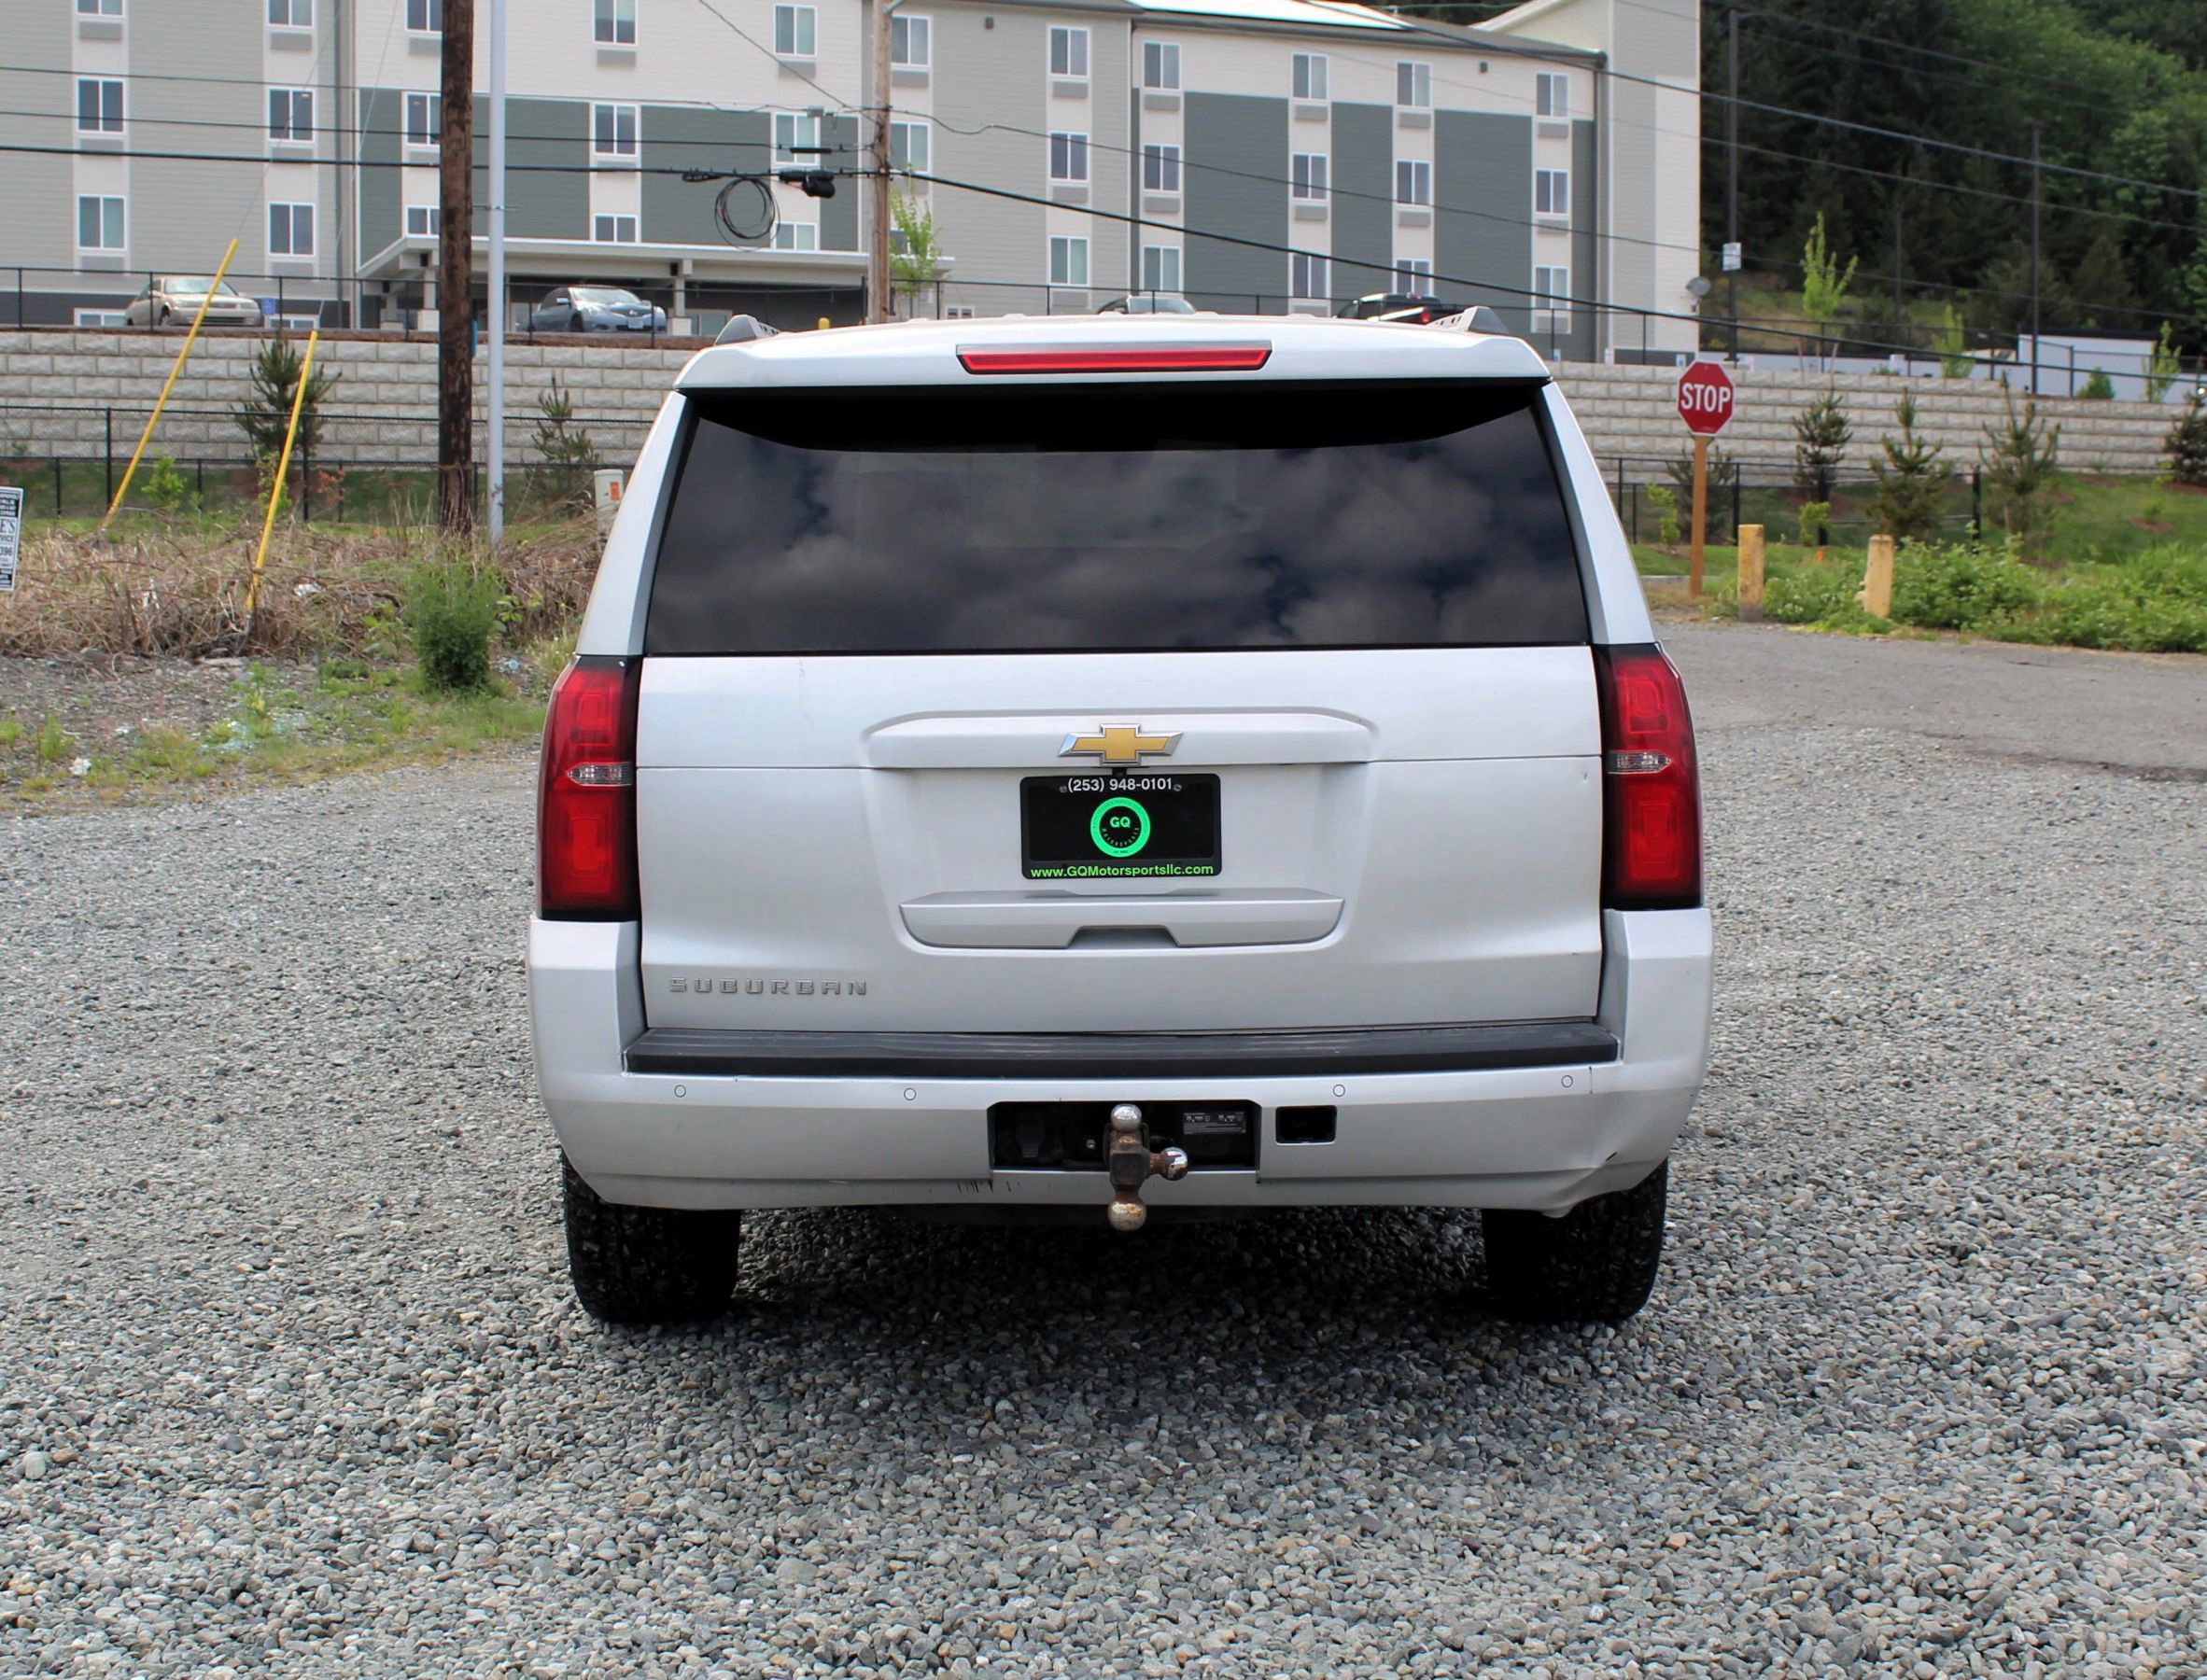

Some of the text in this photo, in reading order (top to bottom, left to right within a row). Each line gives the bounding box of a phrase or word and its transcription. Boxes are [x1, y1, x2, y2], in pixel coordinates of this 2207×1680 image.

[1680, 382, 1731, 413] STOP
[1067, 777, 1173, 793] (253) 948-0101
[1109, 816, 1132, 828] GQ
[1030, 863, 1215, 878] www.GQMotorsportsllc.com
[669, 976, 867, 996] SUBURBAN
